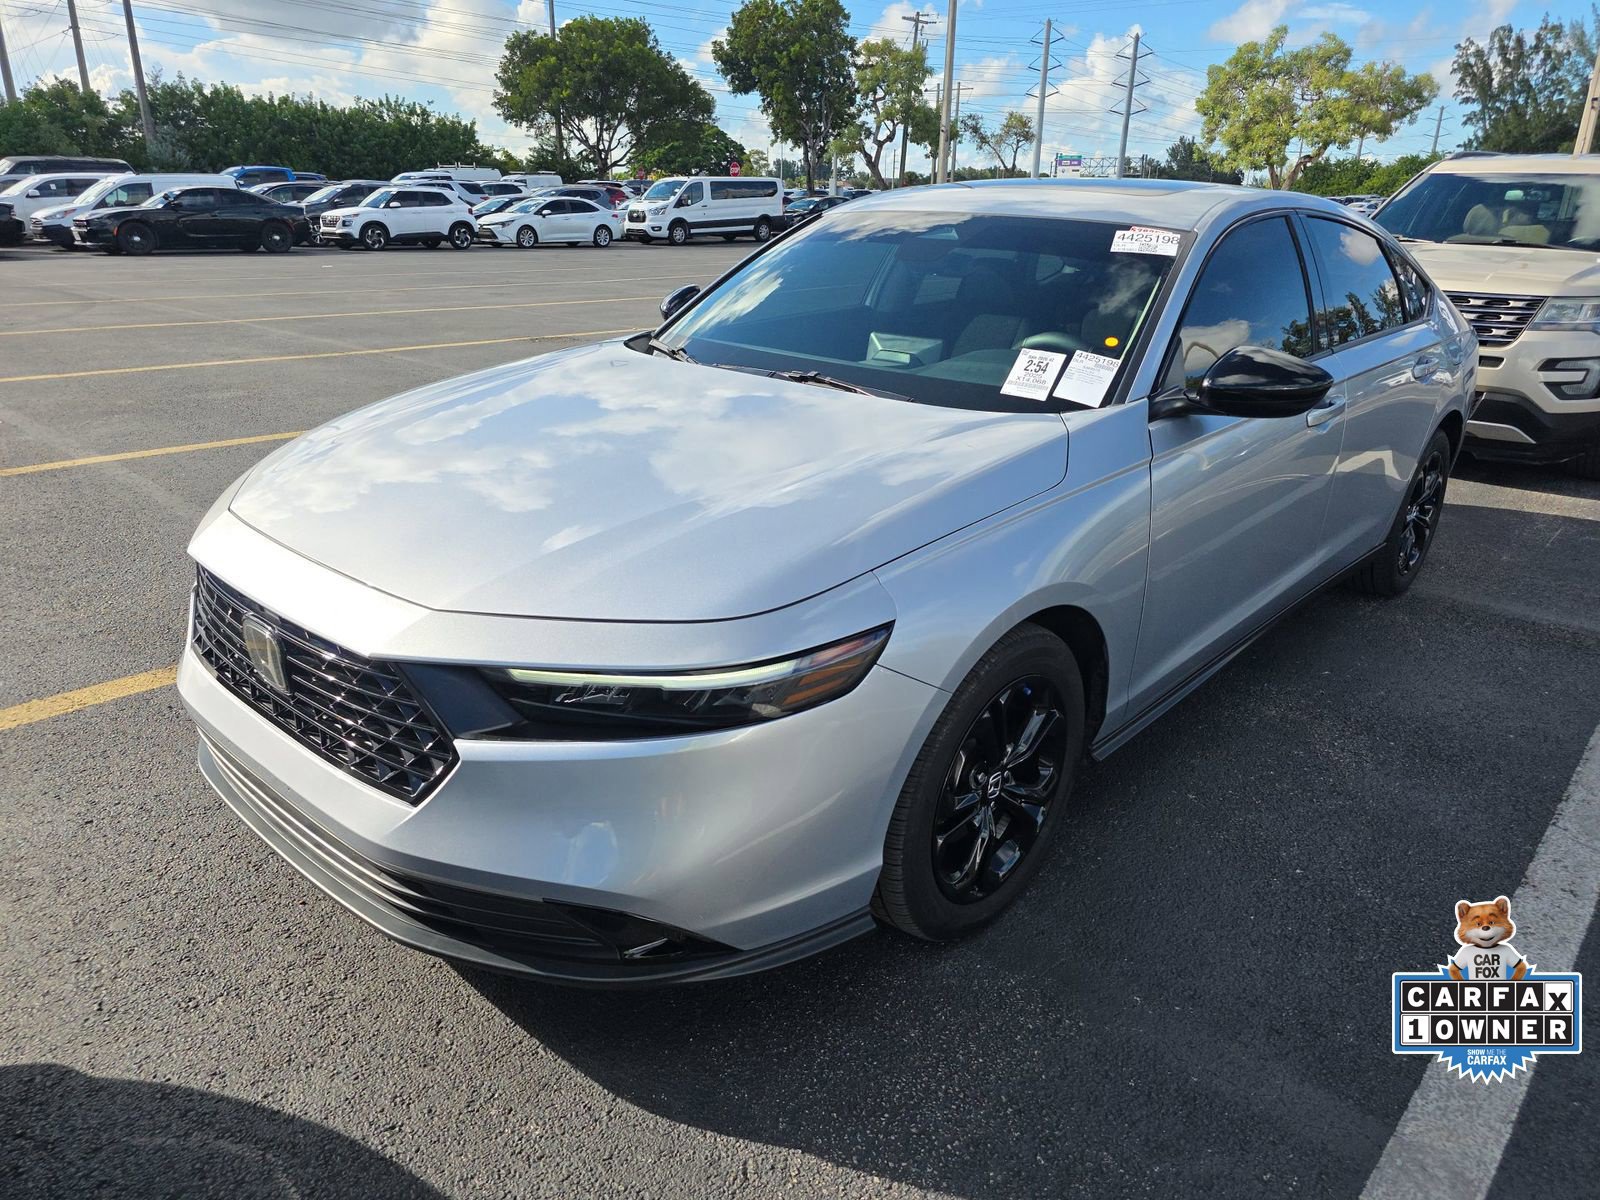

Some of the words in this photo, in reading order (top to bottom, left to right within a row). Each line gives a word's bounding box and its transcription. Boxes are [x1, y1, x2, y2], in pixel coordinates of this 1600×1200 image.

[1117, 233, 1180, 244] 4425198
[1024, 360, 1049, 374] 2:54
[1077, 353, 1119, 367] 4425198
